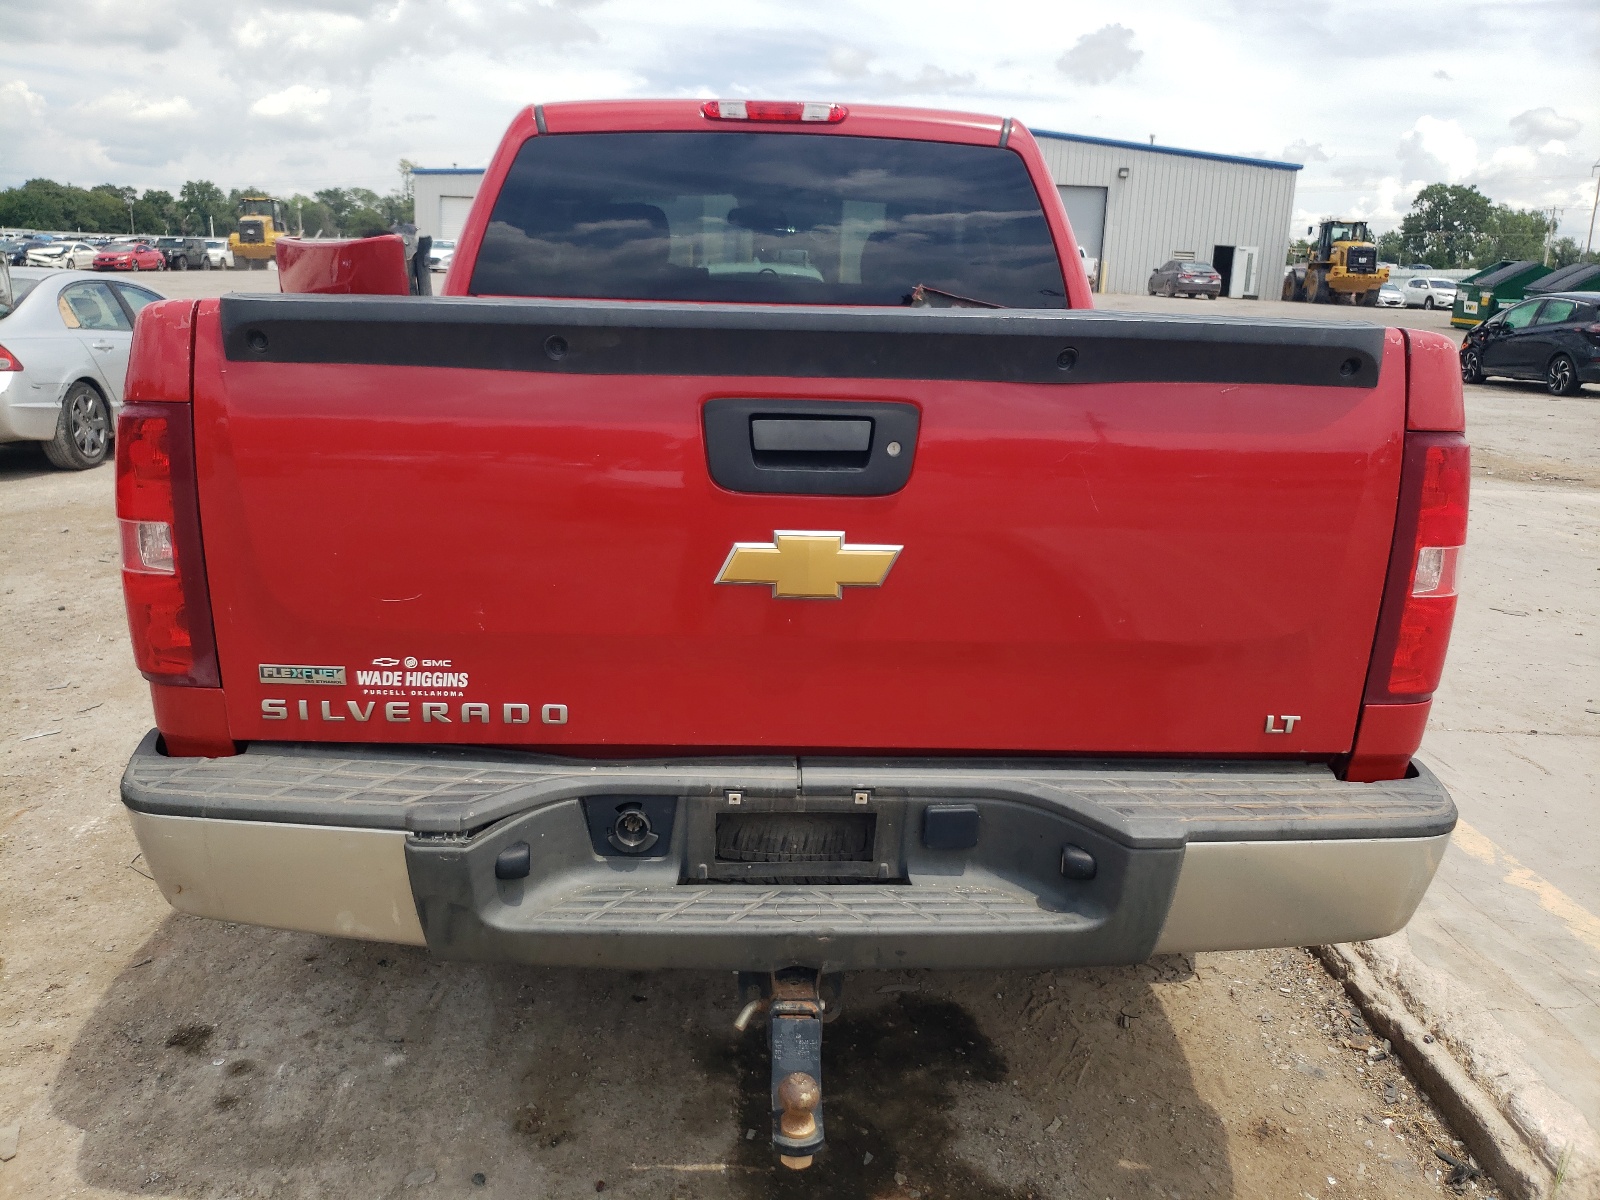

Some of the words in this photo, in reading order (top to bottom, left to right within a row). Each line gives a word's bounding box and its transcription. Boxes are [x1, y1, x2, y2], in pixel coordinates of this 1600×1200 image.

[422, 659, 452, 667] GMC
[356, 670, 403, 686] WADE
[405, 671, 469, 688] HIGGINS
[261, 699, 568, 725] SILVERADO
[1265, 715, 1301, 734] LT
